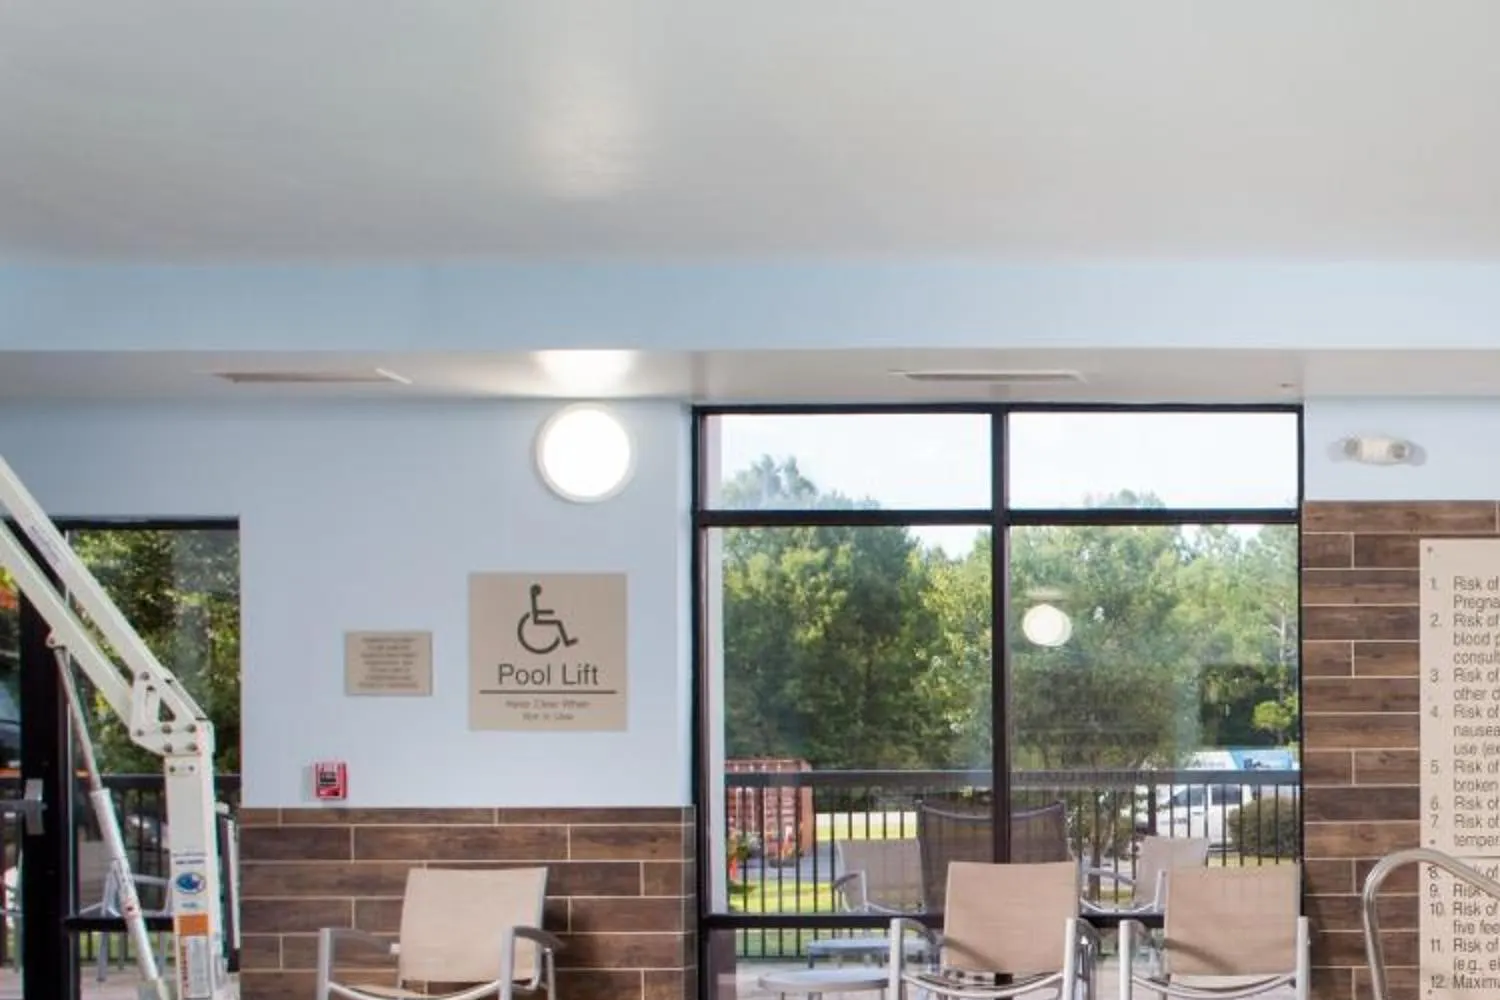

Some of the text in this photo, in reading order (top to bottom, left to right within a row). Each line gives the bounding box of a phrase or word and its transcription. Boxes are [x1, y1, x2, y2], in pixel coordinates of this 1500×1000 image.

[1453, 576, 1482, 590] Risk
[1453, 613, 1483, 627] Risk
[1453, 631, 1490, 645] blood
[498, 663, 598, 686] Pool Lift
[1453, 668, 1482, 682] Risk
[1453, 686, 1487, 700] other
[1453, 704, 1482, 718] Risk
[1454, 743, 1478, 754] use
[1453, 778, 1499, 792] broken
[1454, 814, 1483, 828] Risk
[1452, 902, 1481, 916] Risk
[1453, 921, 1475, 935] five
[1453, 939, 1482, 953] Risk
